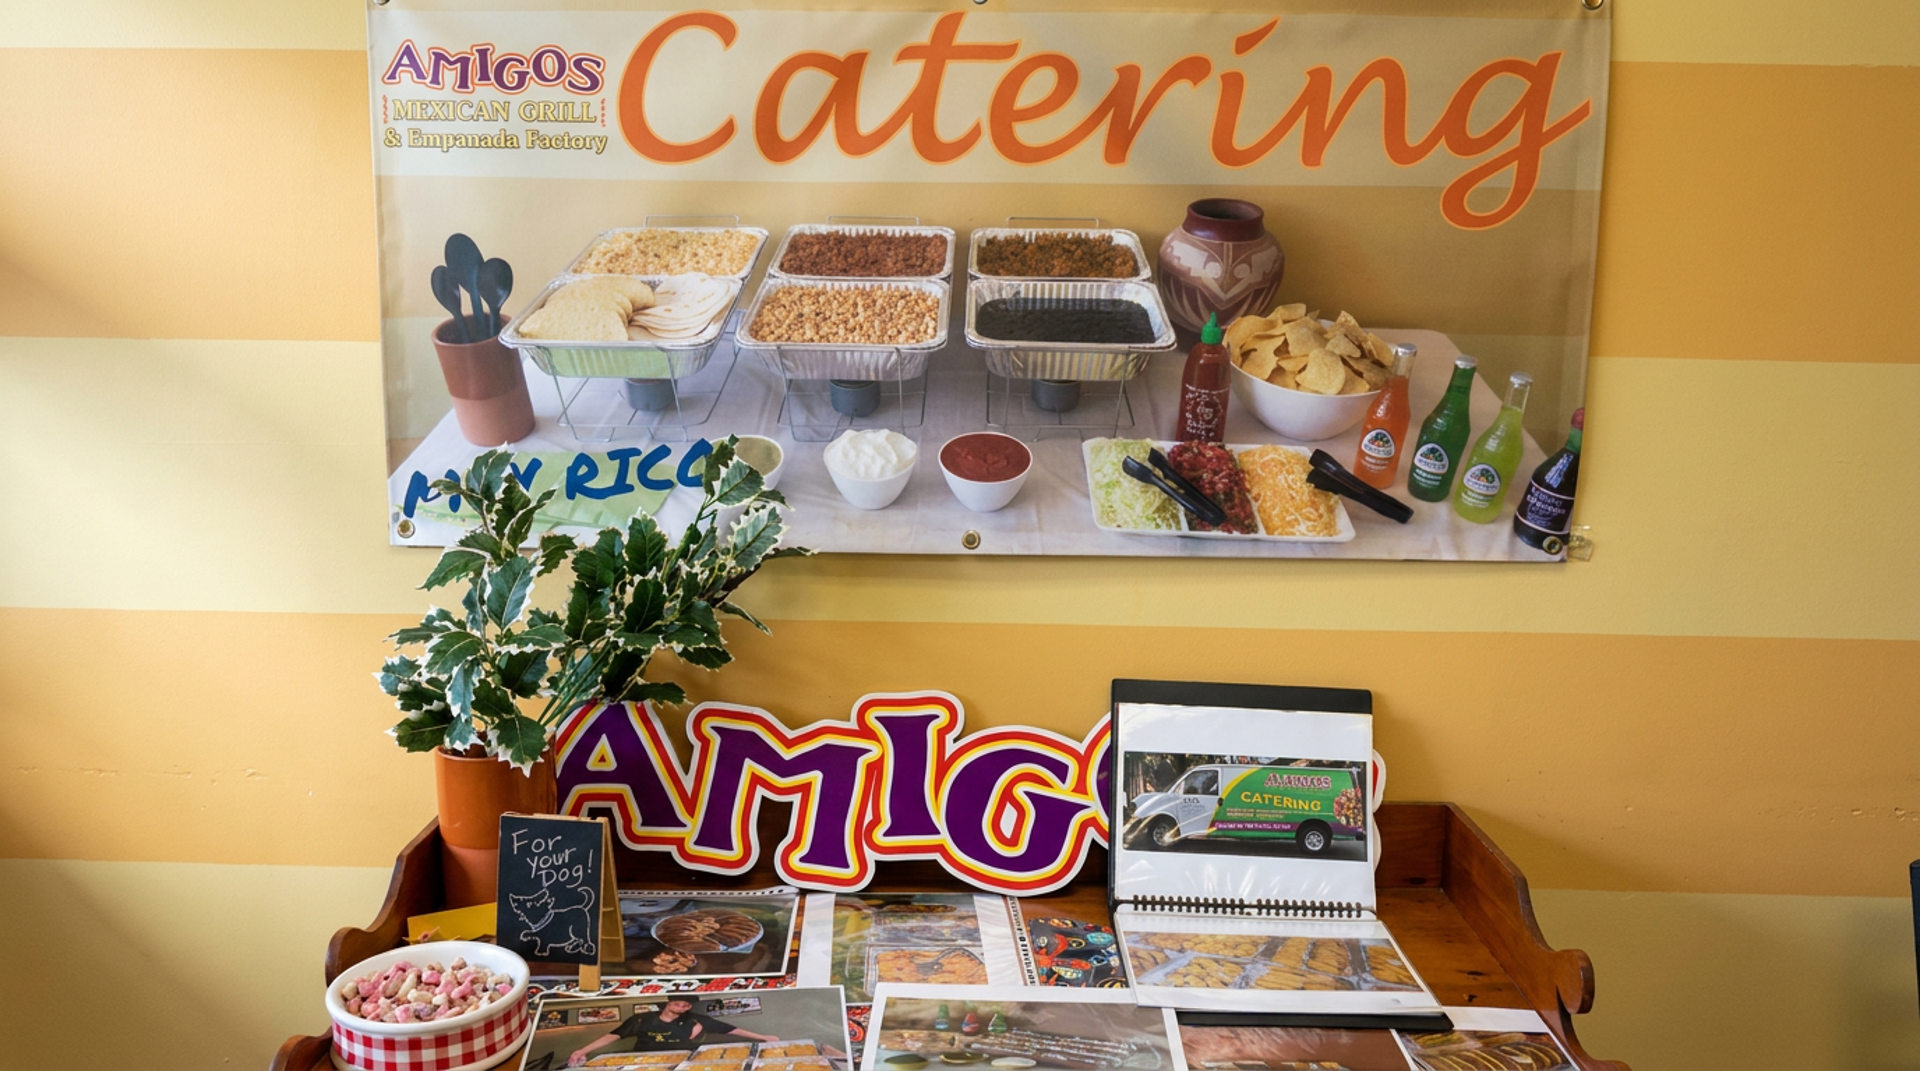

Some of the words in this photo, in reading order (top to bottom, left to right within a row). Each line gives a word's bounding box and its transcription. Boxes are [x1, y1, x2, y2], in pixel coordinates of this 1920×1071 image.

[383, 39, 605, 95] AMIGOS
[392, 99, 510, 122] MEXICAN
[518, 101, 597, 123] GRILL
[616, 9, 1592, 230] Catering
[384, 127, 402, 147] &
[408, 128, 520, 152] Empanada
[525, 130, 608, 154] Factory
[403, 457, 543, 519] MY
[555, 692, 1112, 897] AMIG
[1241, 791, 1321, 811] CATERING
[511, 828, 562, 855] For
[526, 847, 577, 879] your
[536, 849, 594, 888] Dog!
